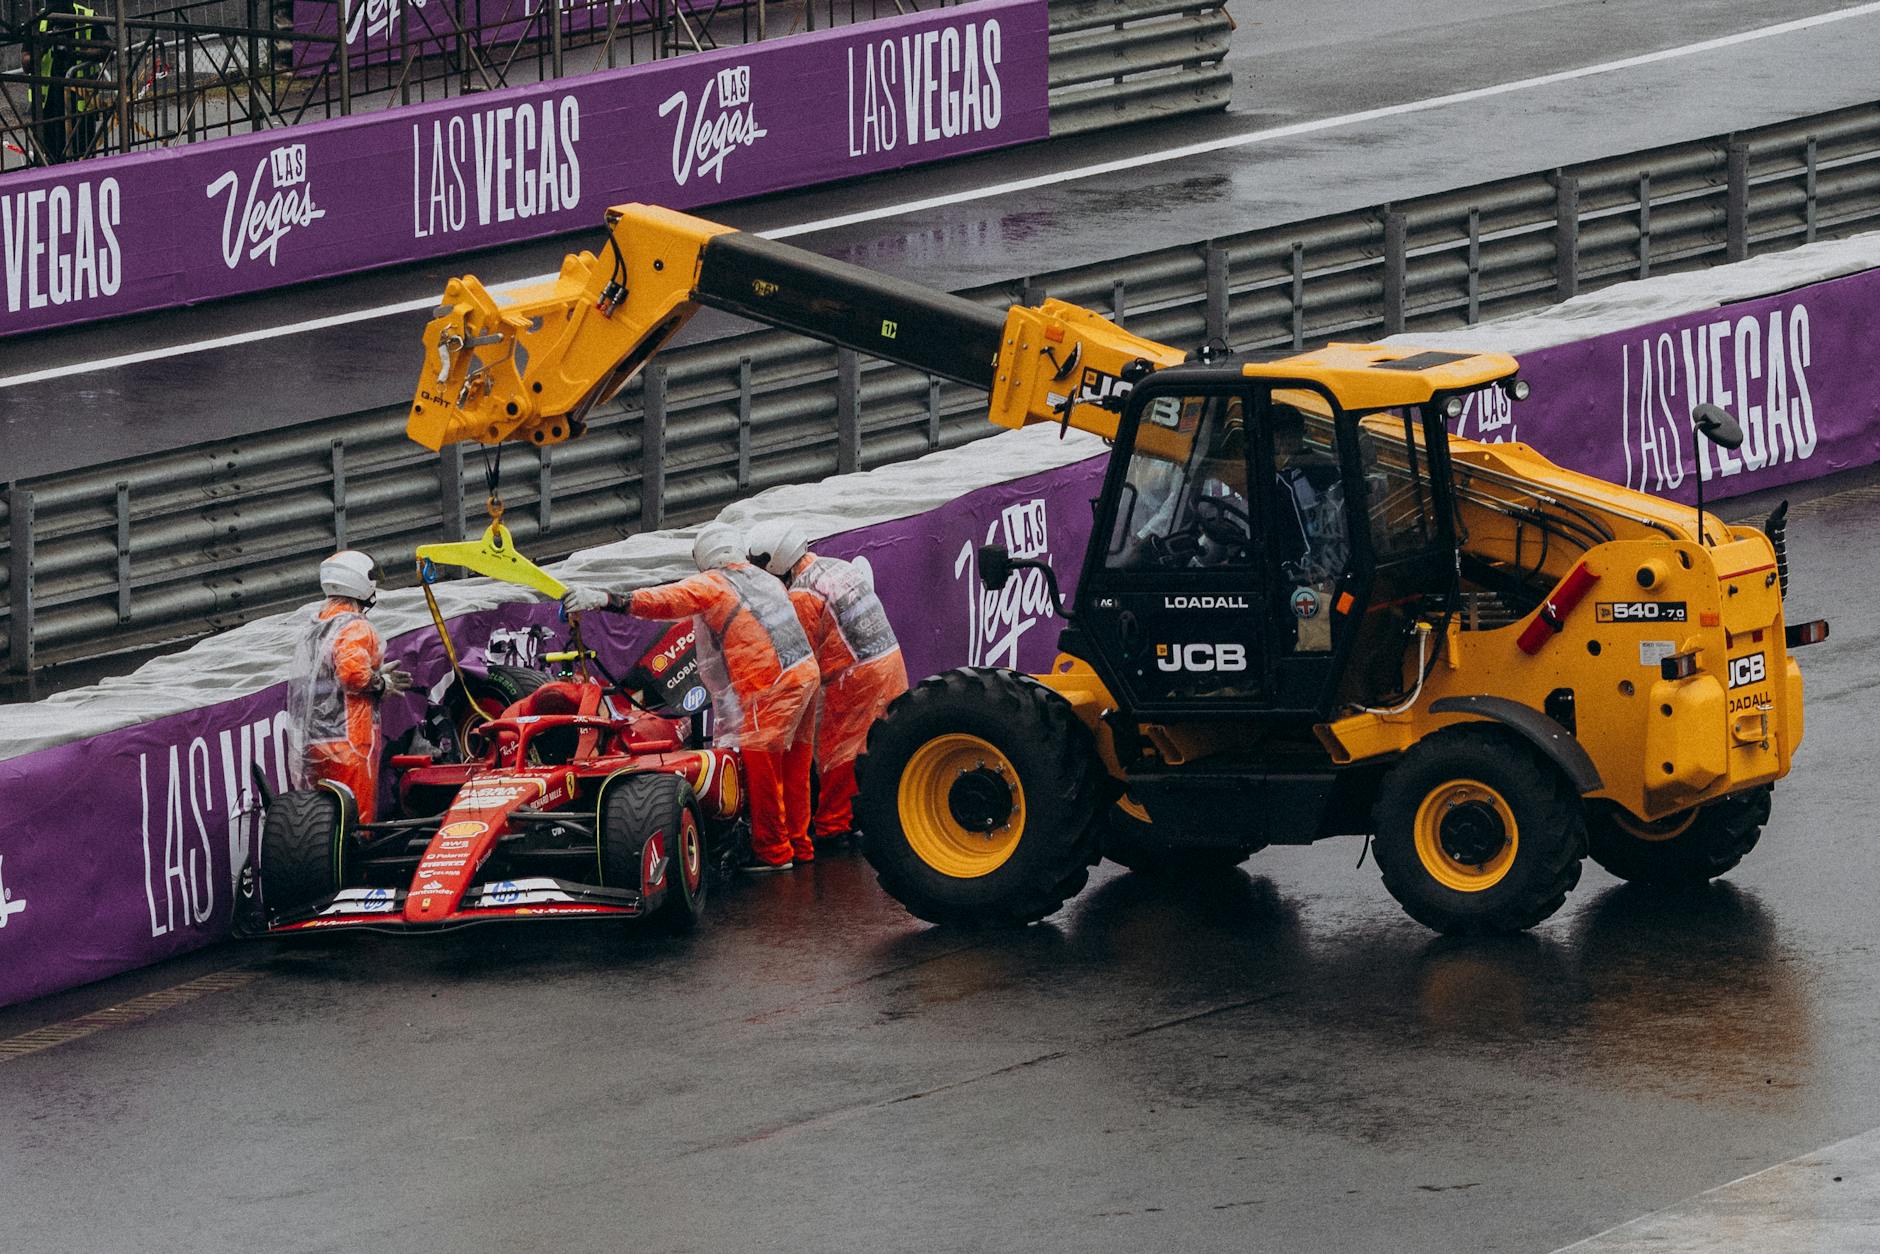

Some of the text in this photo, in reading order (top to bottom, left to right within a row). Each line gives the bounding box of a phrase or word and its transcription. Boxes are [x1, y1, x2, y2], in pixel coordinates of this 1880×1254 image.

[659, 78, 767, 186] Vegas
[720, 67, 749, 106] LAS
[848, 18, 1002, 157] LAS VEGAS
[206, 157, 325, 270] Vegas
[272, 145, 305, 185] LAS
[413, 95, 581, 239] LAS VEGAS
[0, 177, 122, 313] VEGAS
[1681, 304, 1817, 482] VEGAS
[1003, 500, 1047, 558] LAS
[1164, 596, 1249, 609] LOADALL
[1157, 643, 1248, 672] JCB
[1728, 653, 1766, 688] JCB
[139, 736, 215, 938] LAS
